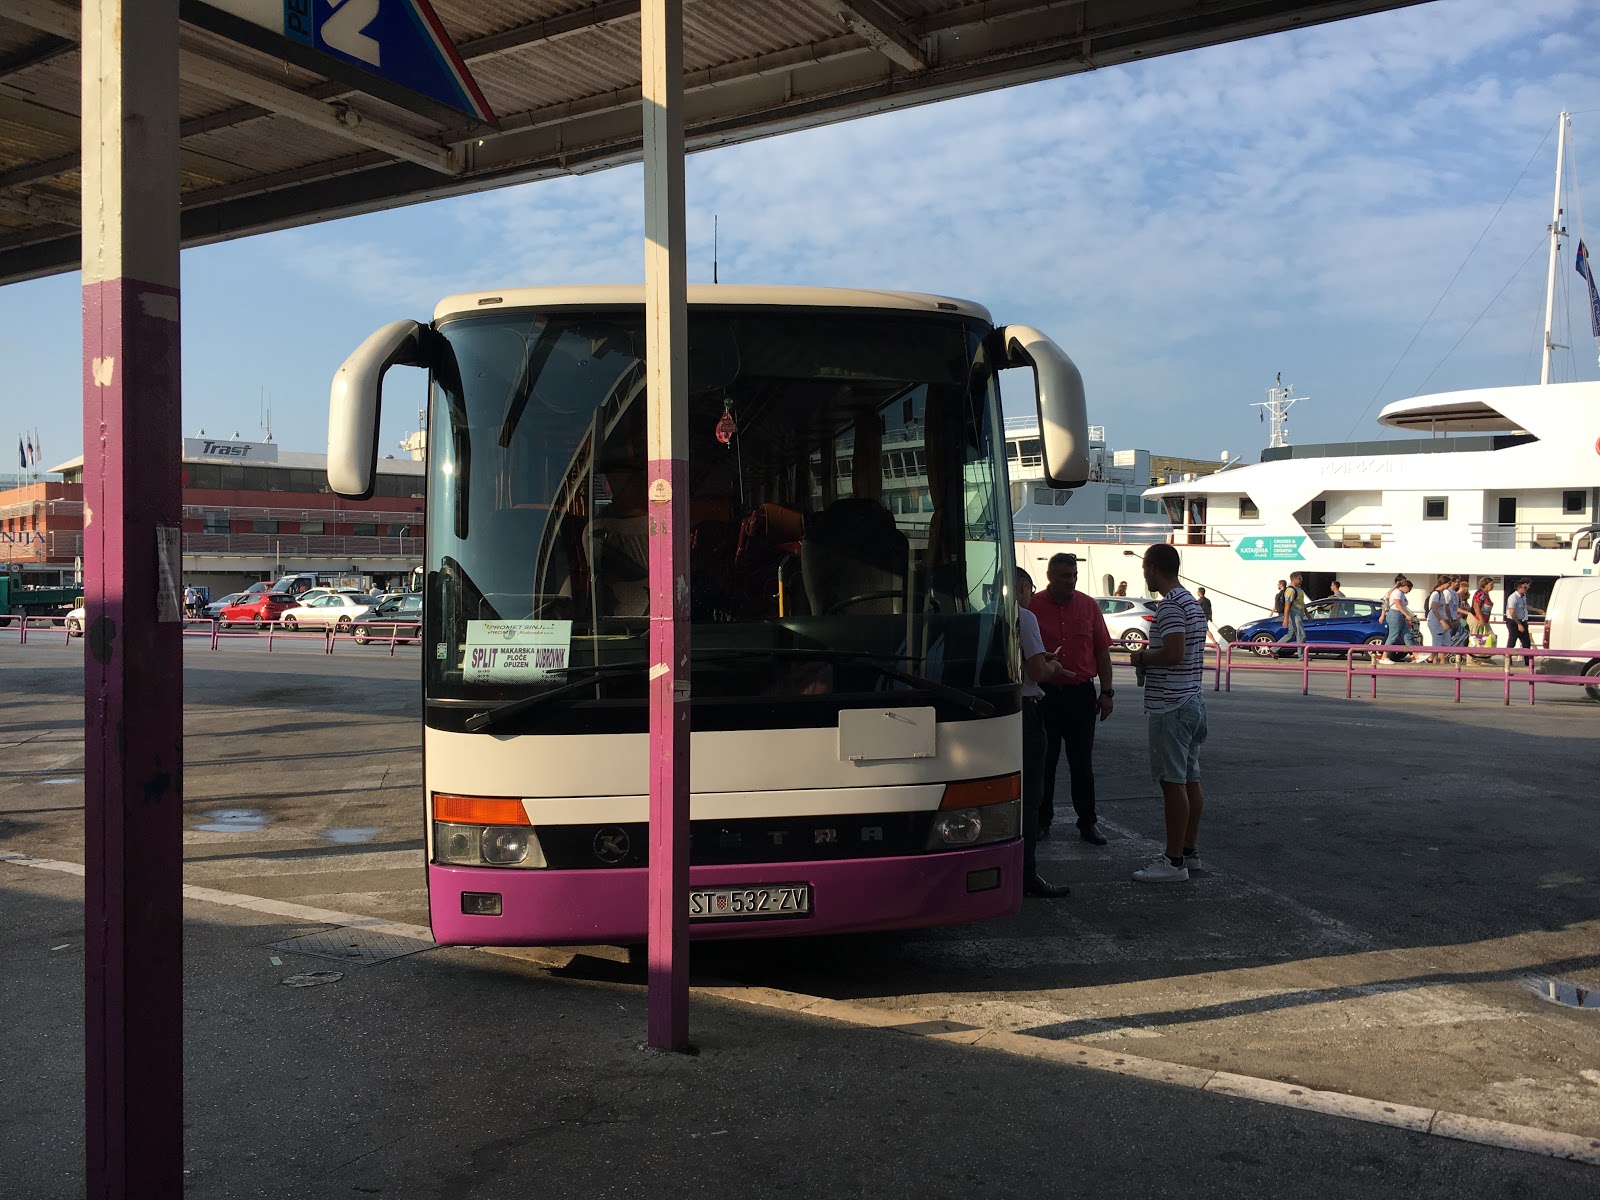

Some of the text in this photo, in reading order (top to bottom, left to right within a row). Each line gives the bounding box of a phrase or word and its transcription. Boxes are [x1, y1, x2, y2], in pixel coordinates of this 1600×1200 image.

[320, 0, 380, 67] 2
[203, 441, 252, 457] Trast
[471, 648, 498, 668] SPLIT
[506, 653, 528, 661] PLOČE
[535, 648, 566, 669] DUBROVNIK
[691, 888, 805, 914] ST 532-ZV
